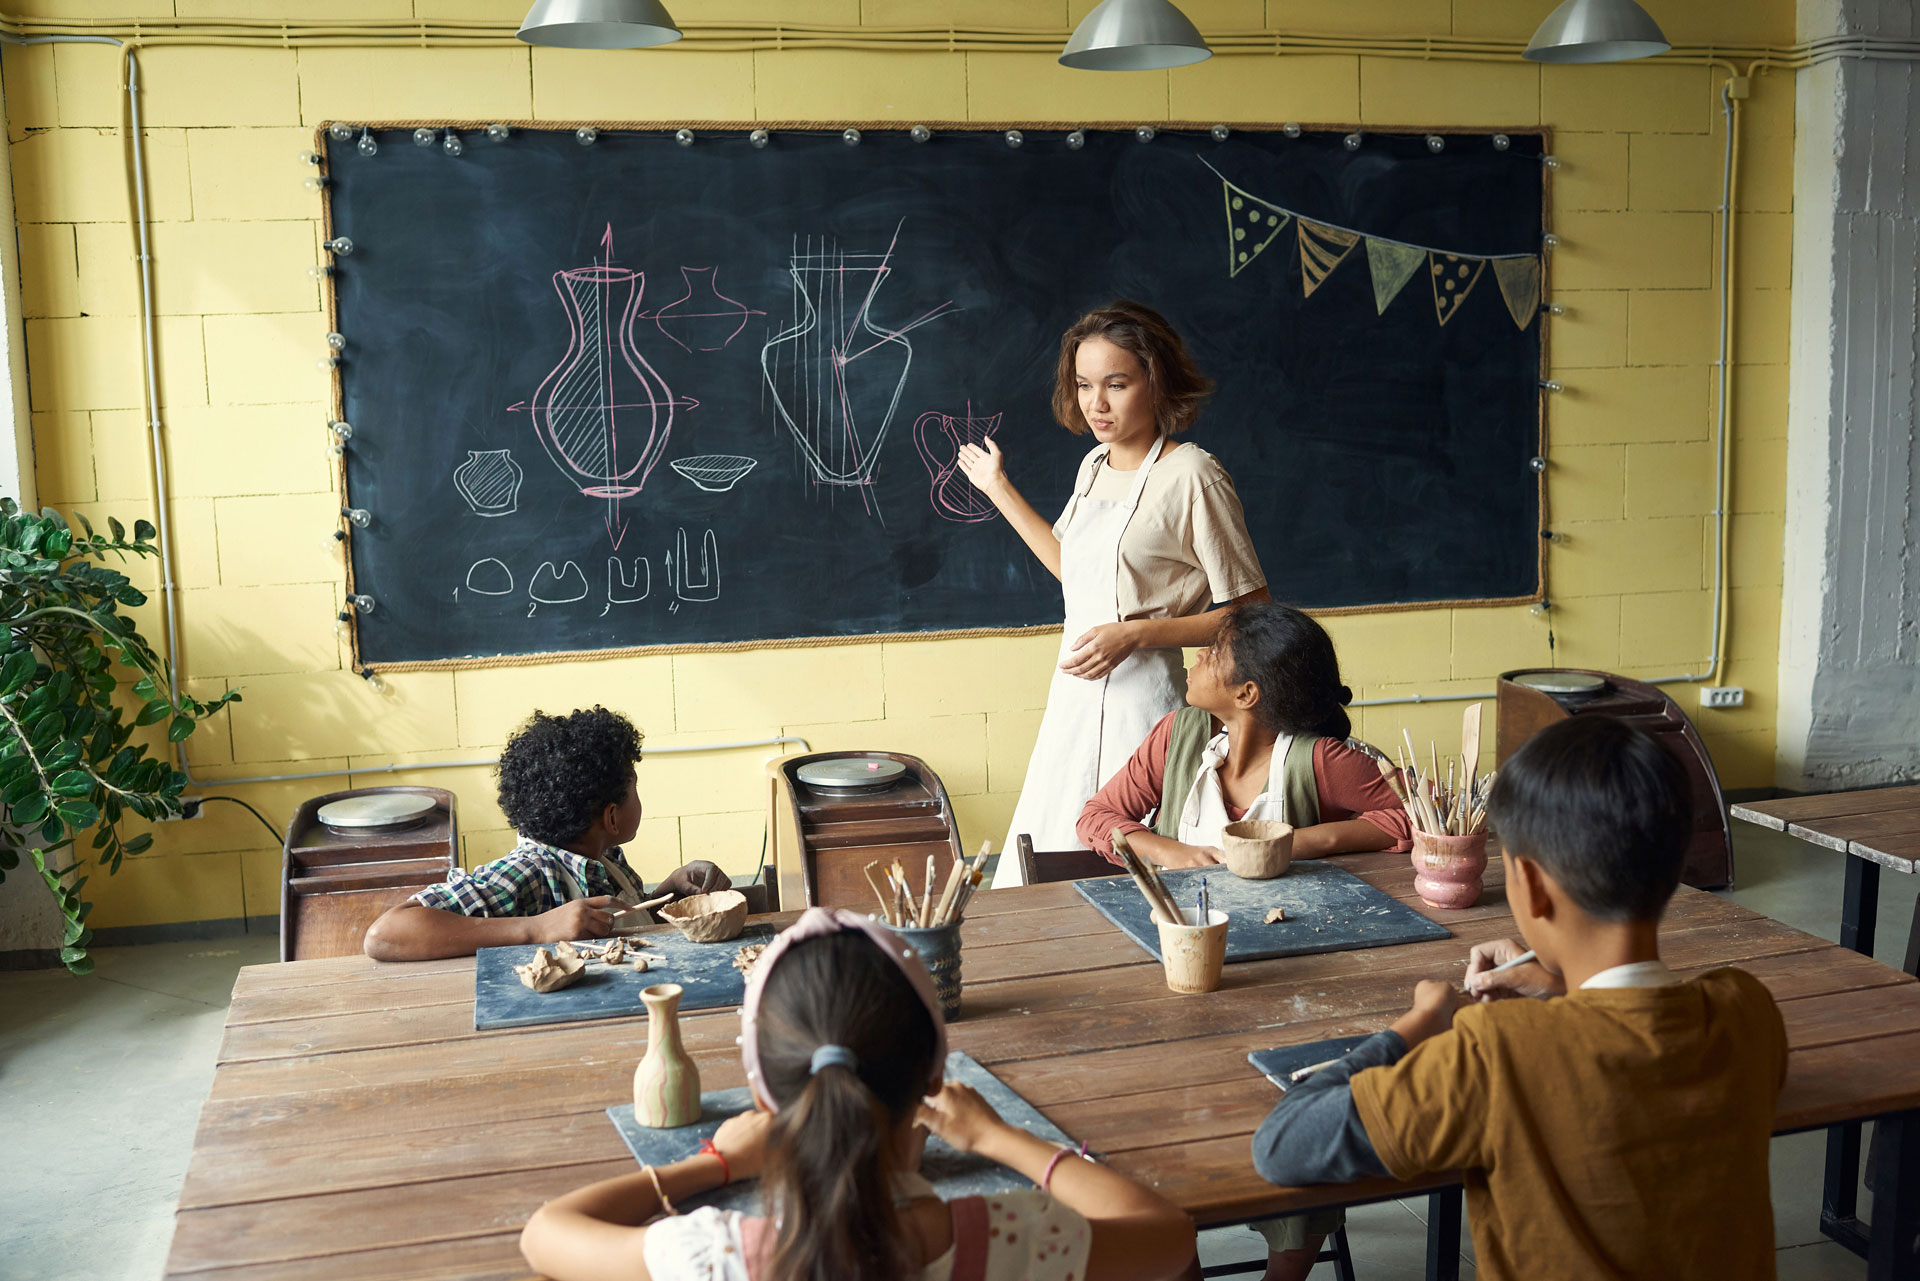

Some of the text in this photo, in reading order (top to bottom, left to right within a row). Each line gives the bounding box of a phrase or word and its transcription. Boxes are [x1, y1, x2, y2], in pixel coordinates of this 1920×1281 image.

[452, 587, 459, 603] 1
[527, 602, 537, 618] 2
[599, 602, 611, 618] 3
[668, 601, 680, 615] 4
